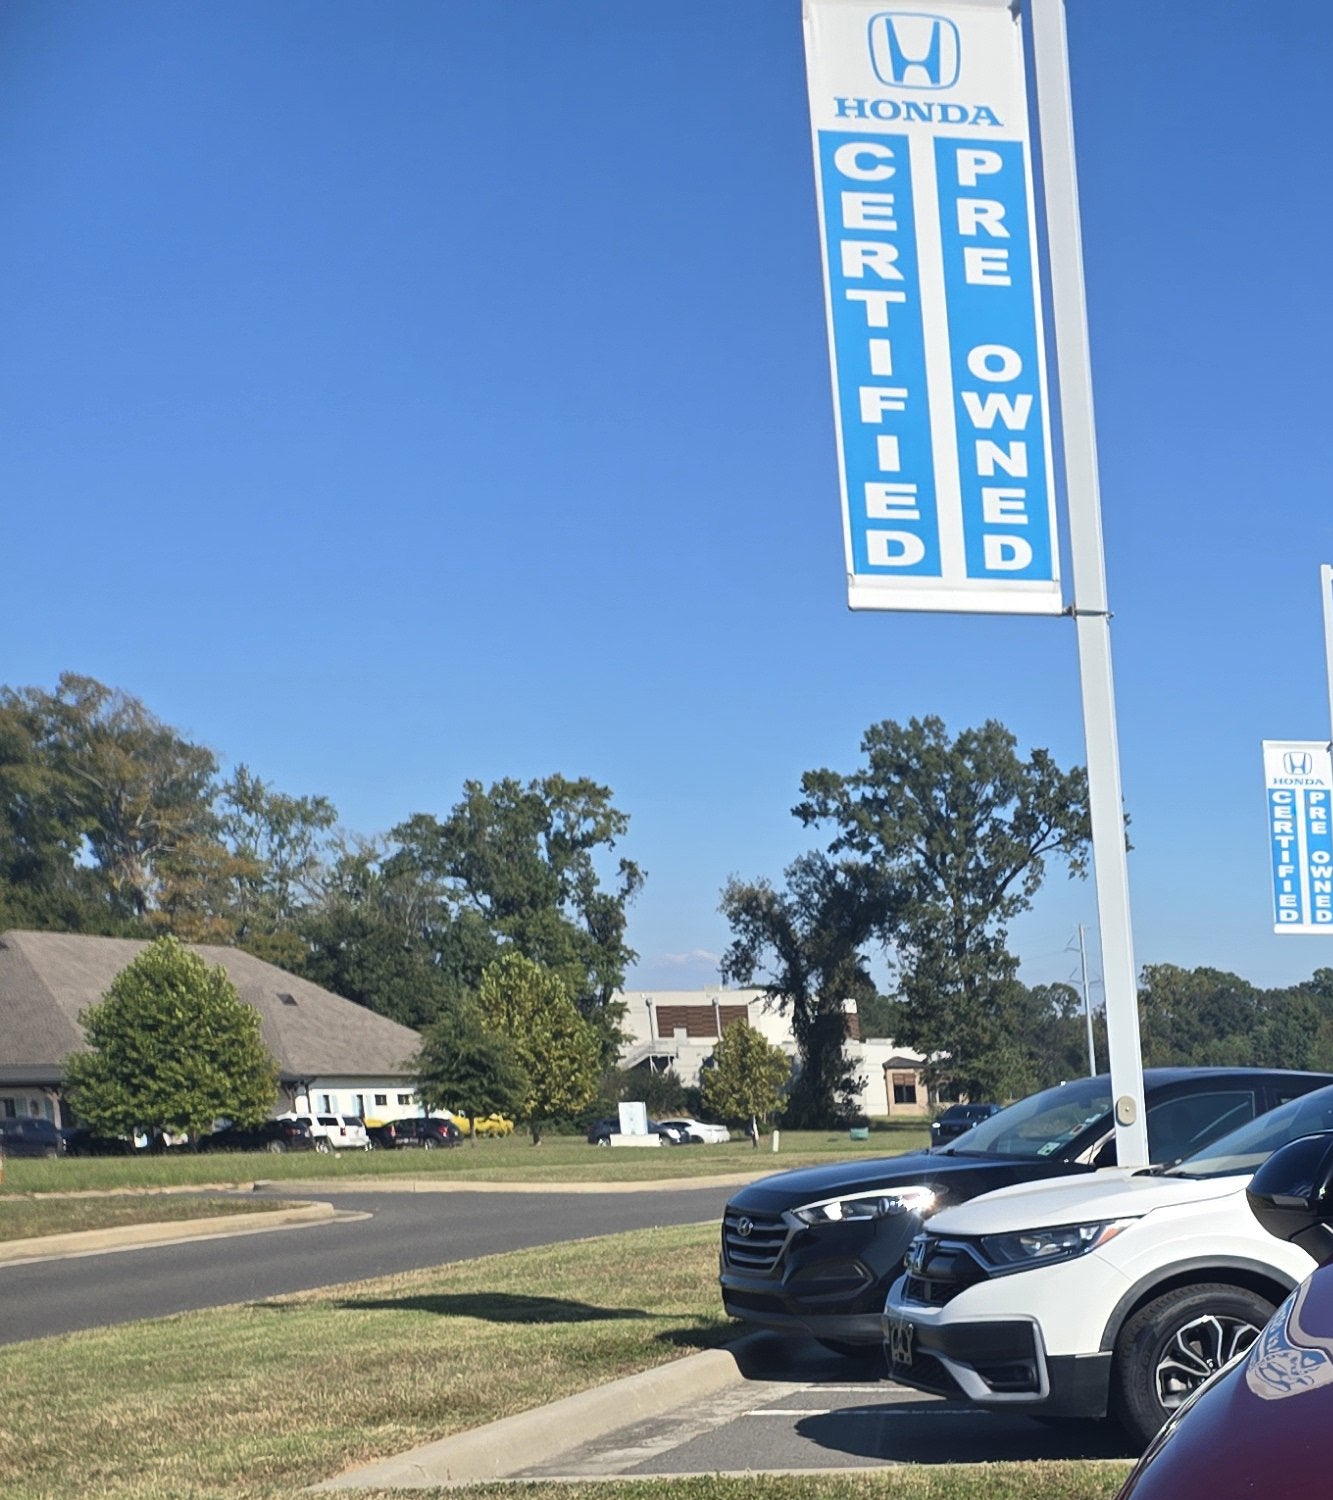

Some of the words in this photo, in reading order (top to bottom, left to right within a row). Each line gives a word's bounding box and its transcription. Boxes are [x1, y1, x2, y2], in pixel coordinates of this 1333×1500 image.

[833, 96, 1004, 128] HONDA
[956, 148, 1012, 287] PRE
[833, 142, 926, 567] CERTIFIED
[961, 343, 1034, 572] OWNED
[1272, 777, 1325, 786] HONDA
[1309, 791, 1327, 835] PRE
[1272, 791, 1299, 923] CERTIFIED
[1310, 850, 1333, 923] OWNED
